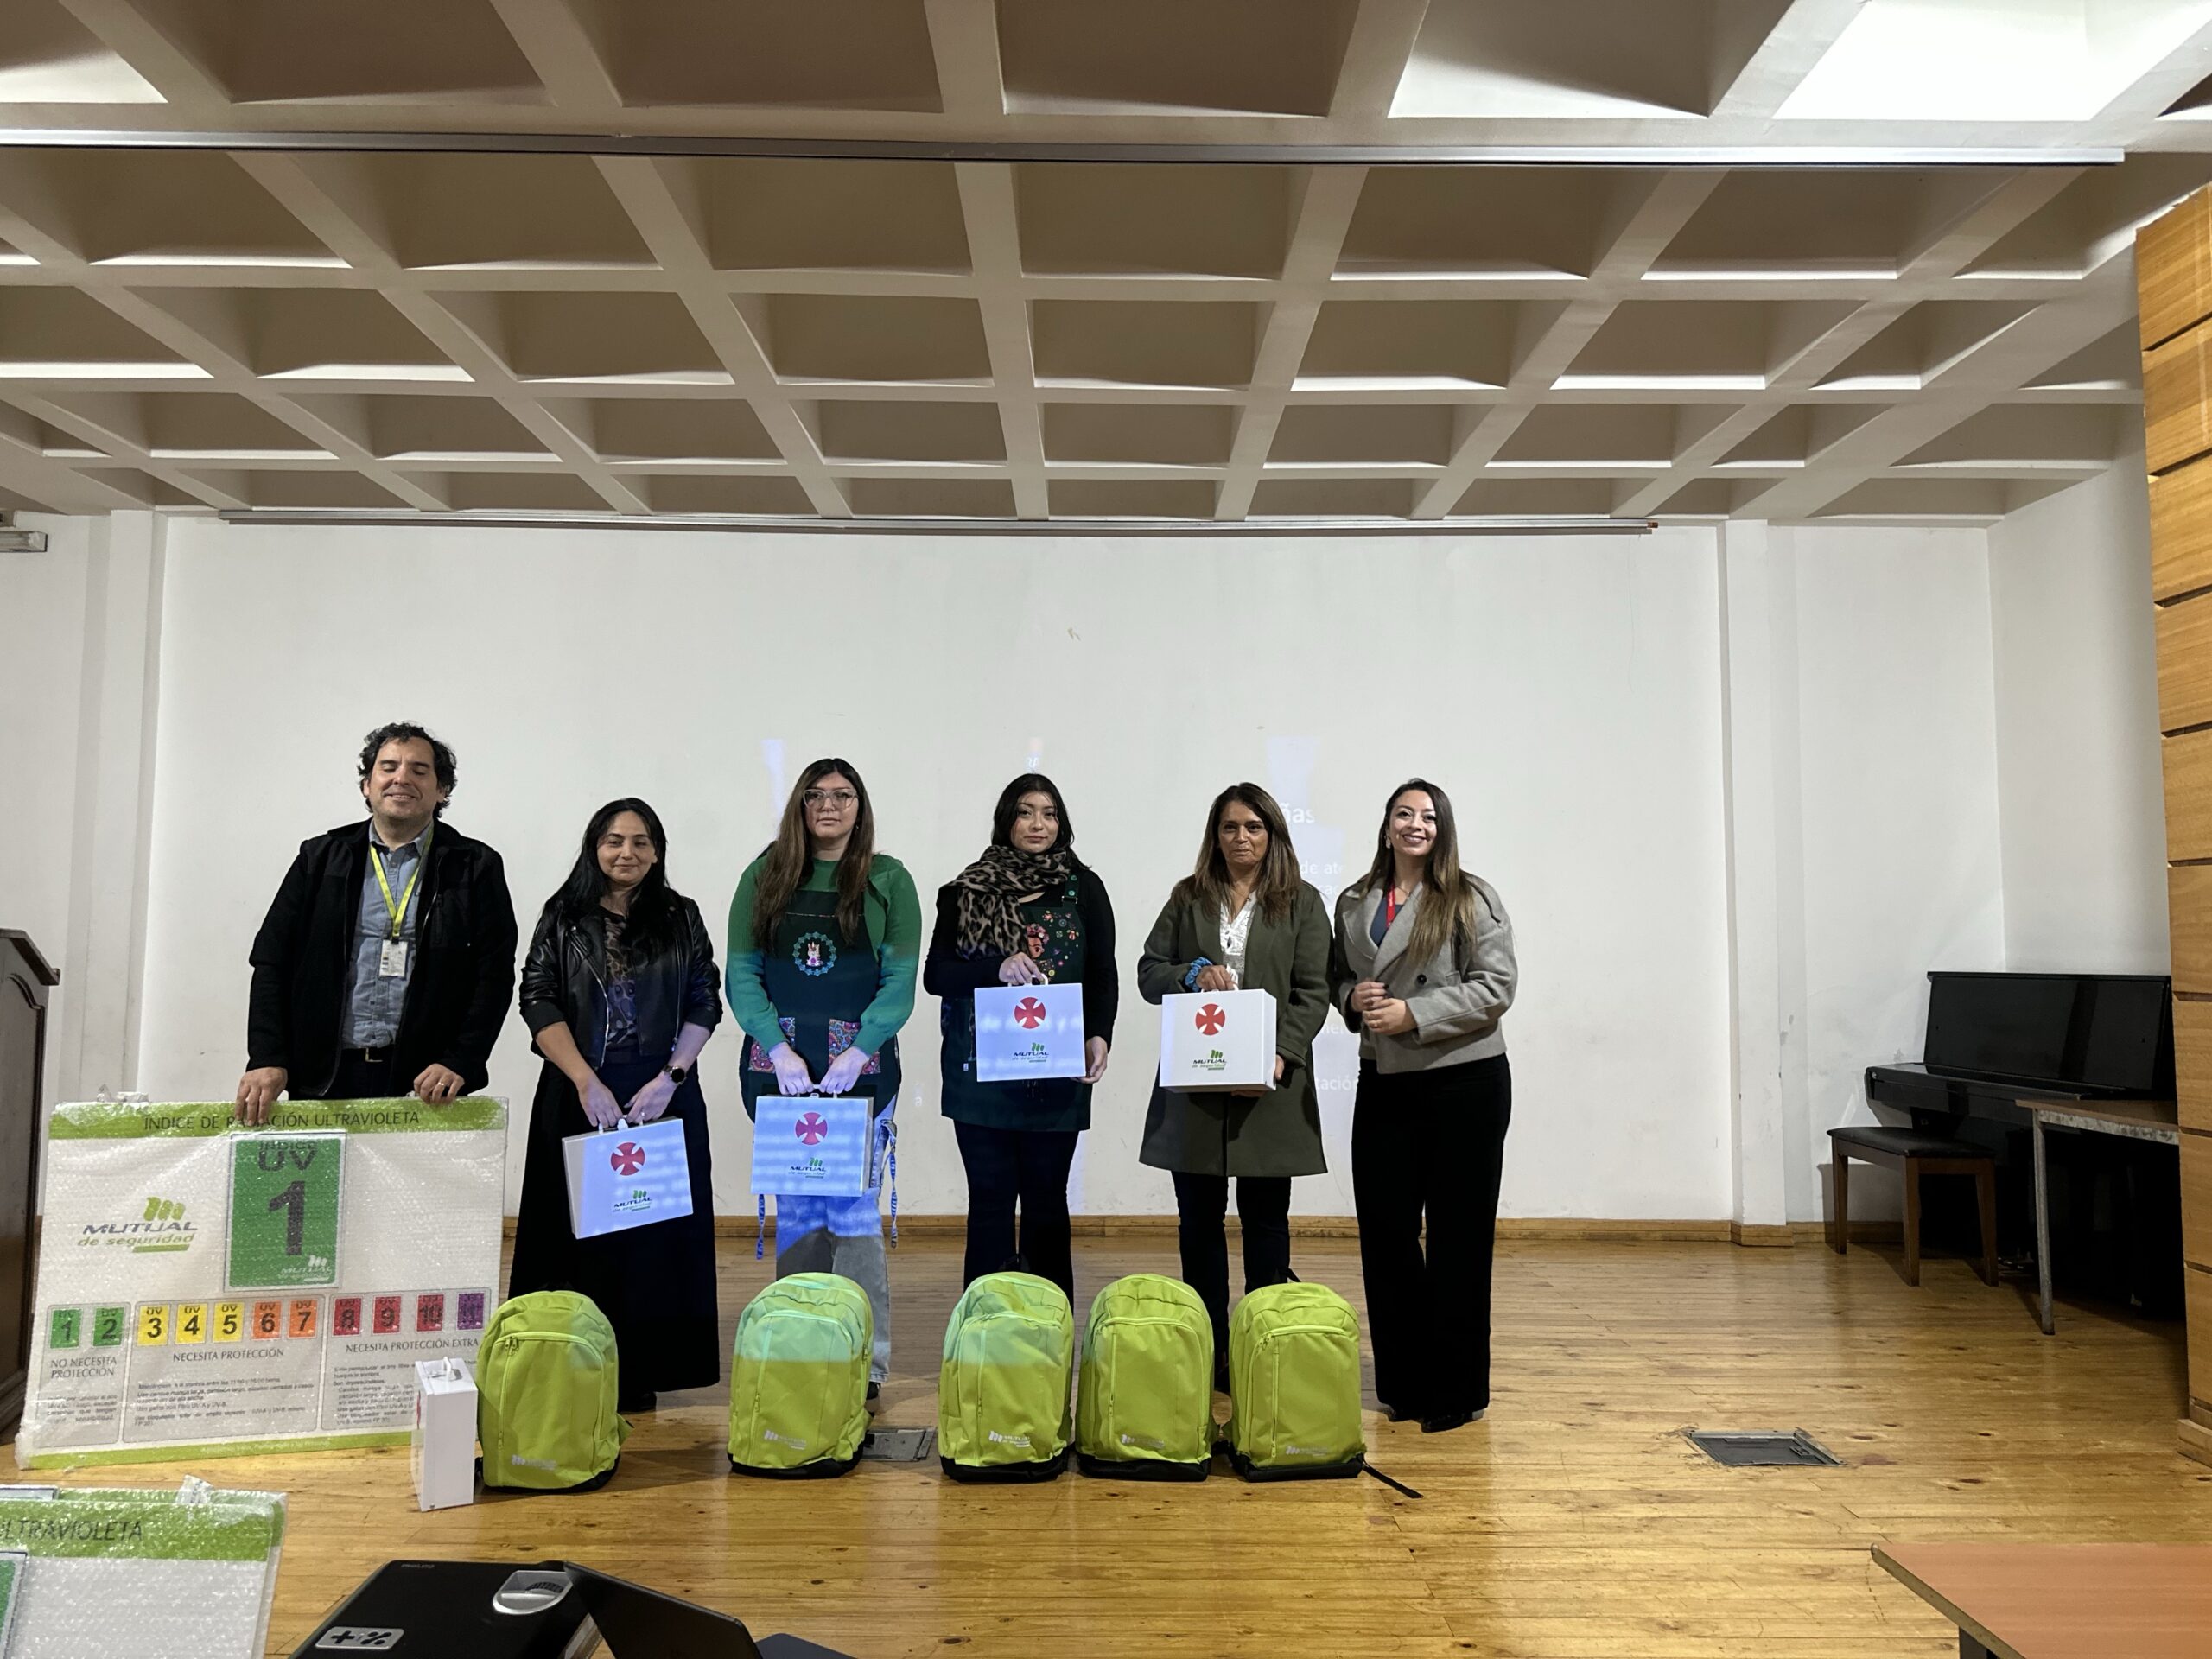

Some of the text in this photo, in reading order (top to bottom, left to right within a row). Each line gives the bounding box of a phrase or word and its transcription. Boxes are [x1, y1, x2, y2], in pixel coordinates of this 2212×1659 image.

[143, 1116, 195, 1130] ÍNDICE
[200, 1116, 219, 1128] DE
[314, 1110, 420, 1126] ULTRAVIOLETA
[258, 1150, 317, 1171] UV
[613, 1197, 652, 1208] MUTUAL
[82, 1221, 198, 1235] MUTUAL
[268, 1180, 306, 1256] 1
[77, 1232, 195, 1247] de seguridad
[184, 1305, 201, 1313] UV
[220, 1303, 238, 1313] UV
[61, 1320, 73, 1341] 1
[102, 1318, 118, 1340] 2
[147, 1317, 162, 1338] 3
[184, 1315, 200, 1336] 4
[222, 1314, 238, 1335] 5
[260, 1313, 275, 1333] 6
[297, 1311, 311, 1332] 7
[173, 1347, 284, 1362] NECESITA PROTECCIÓN
[346, 1338, 479, 1353] NECESITA PROTECCIÓN EXTRA
[50, 1357, 118, 1369] NO NECESITA
[50, 1366, 115, 1379] PROTECCIÓN
